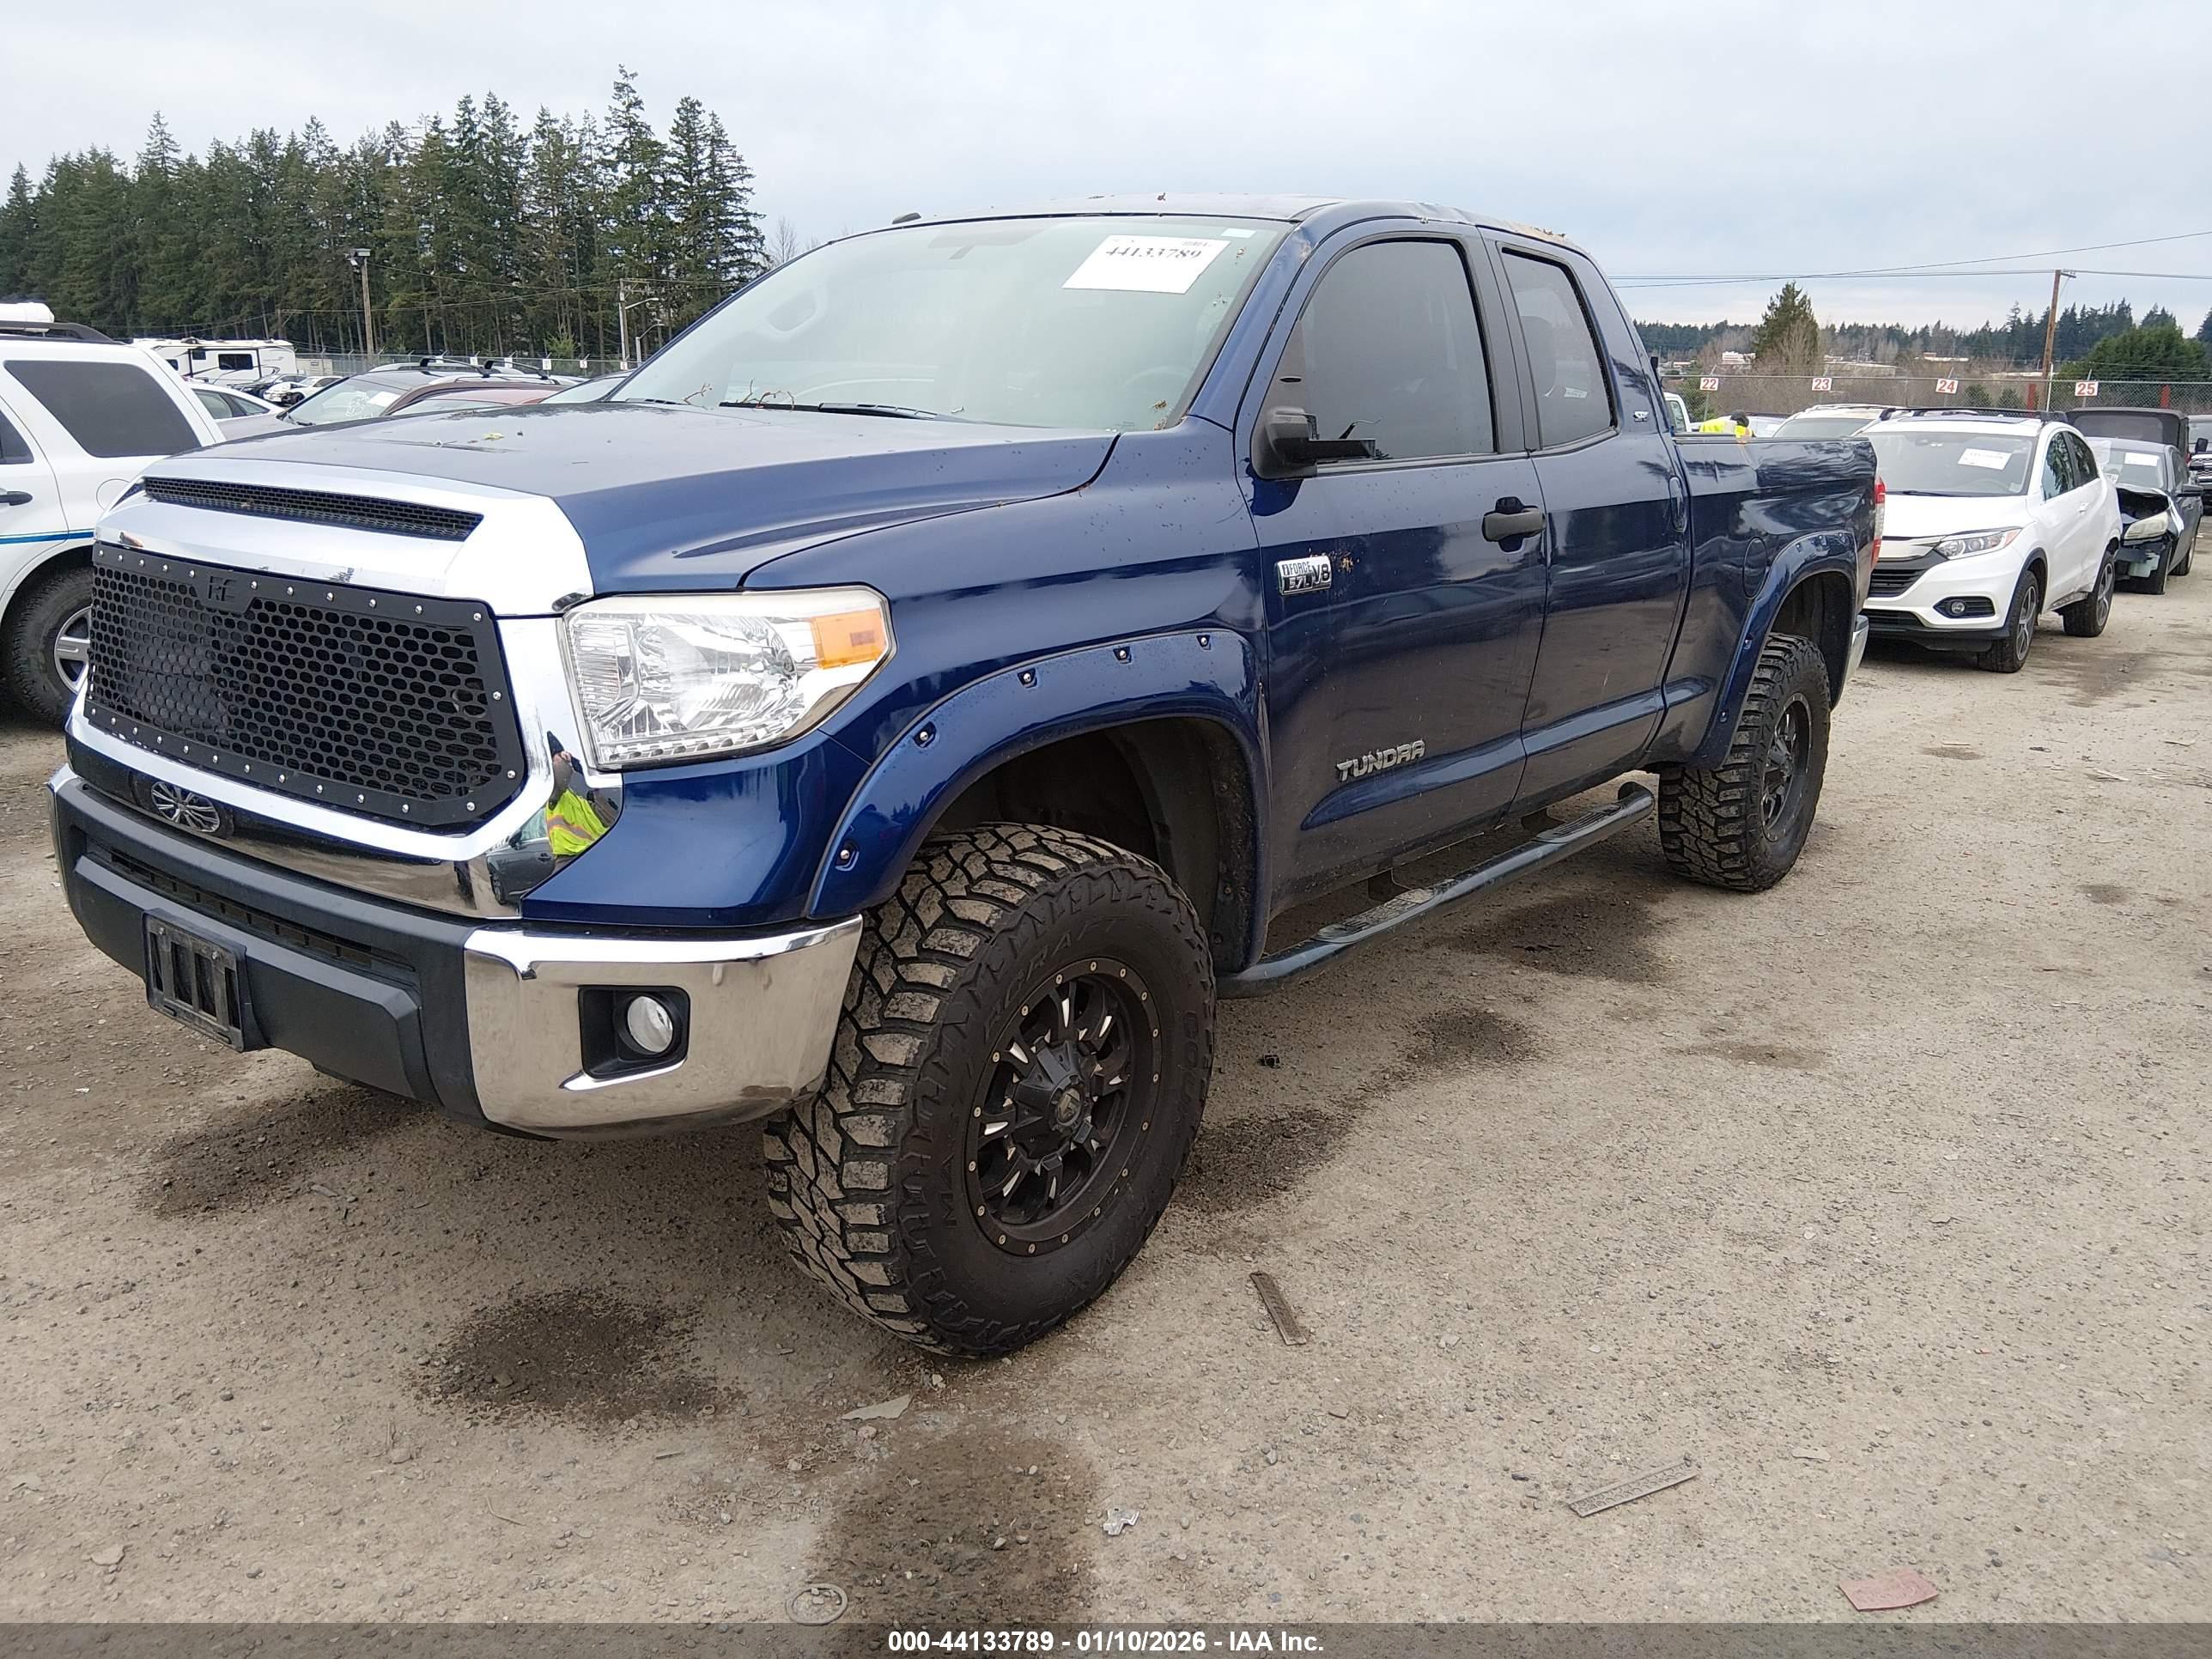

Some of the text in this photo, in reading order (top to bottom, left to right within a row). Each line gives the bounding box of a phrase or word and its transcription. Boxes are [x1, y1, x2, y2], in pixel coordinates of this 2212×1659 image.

[1701, 379, 1717, 390] 22
[1814, 378, 1830, 390] 23
[1937, 380, 1956, 392] 24
[2076, 382, 2096, 396] 25
[1311, 562, 1331, 582] V8
[1336, 738, 1426, 782] TUNDRA
